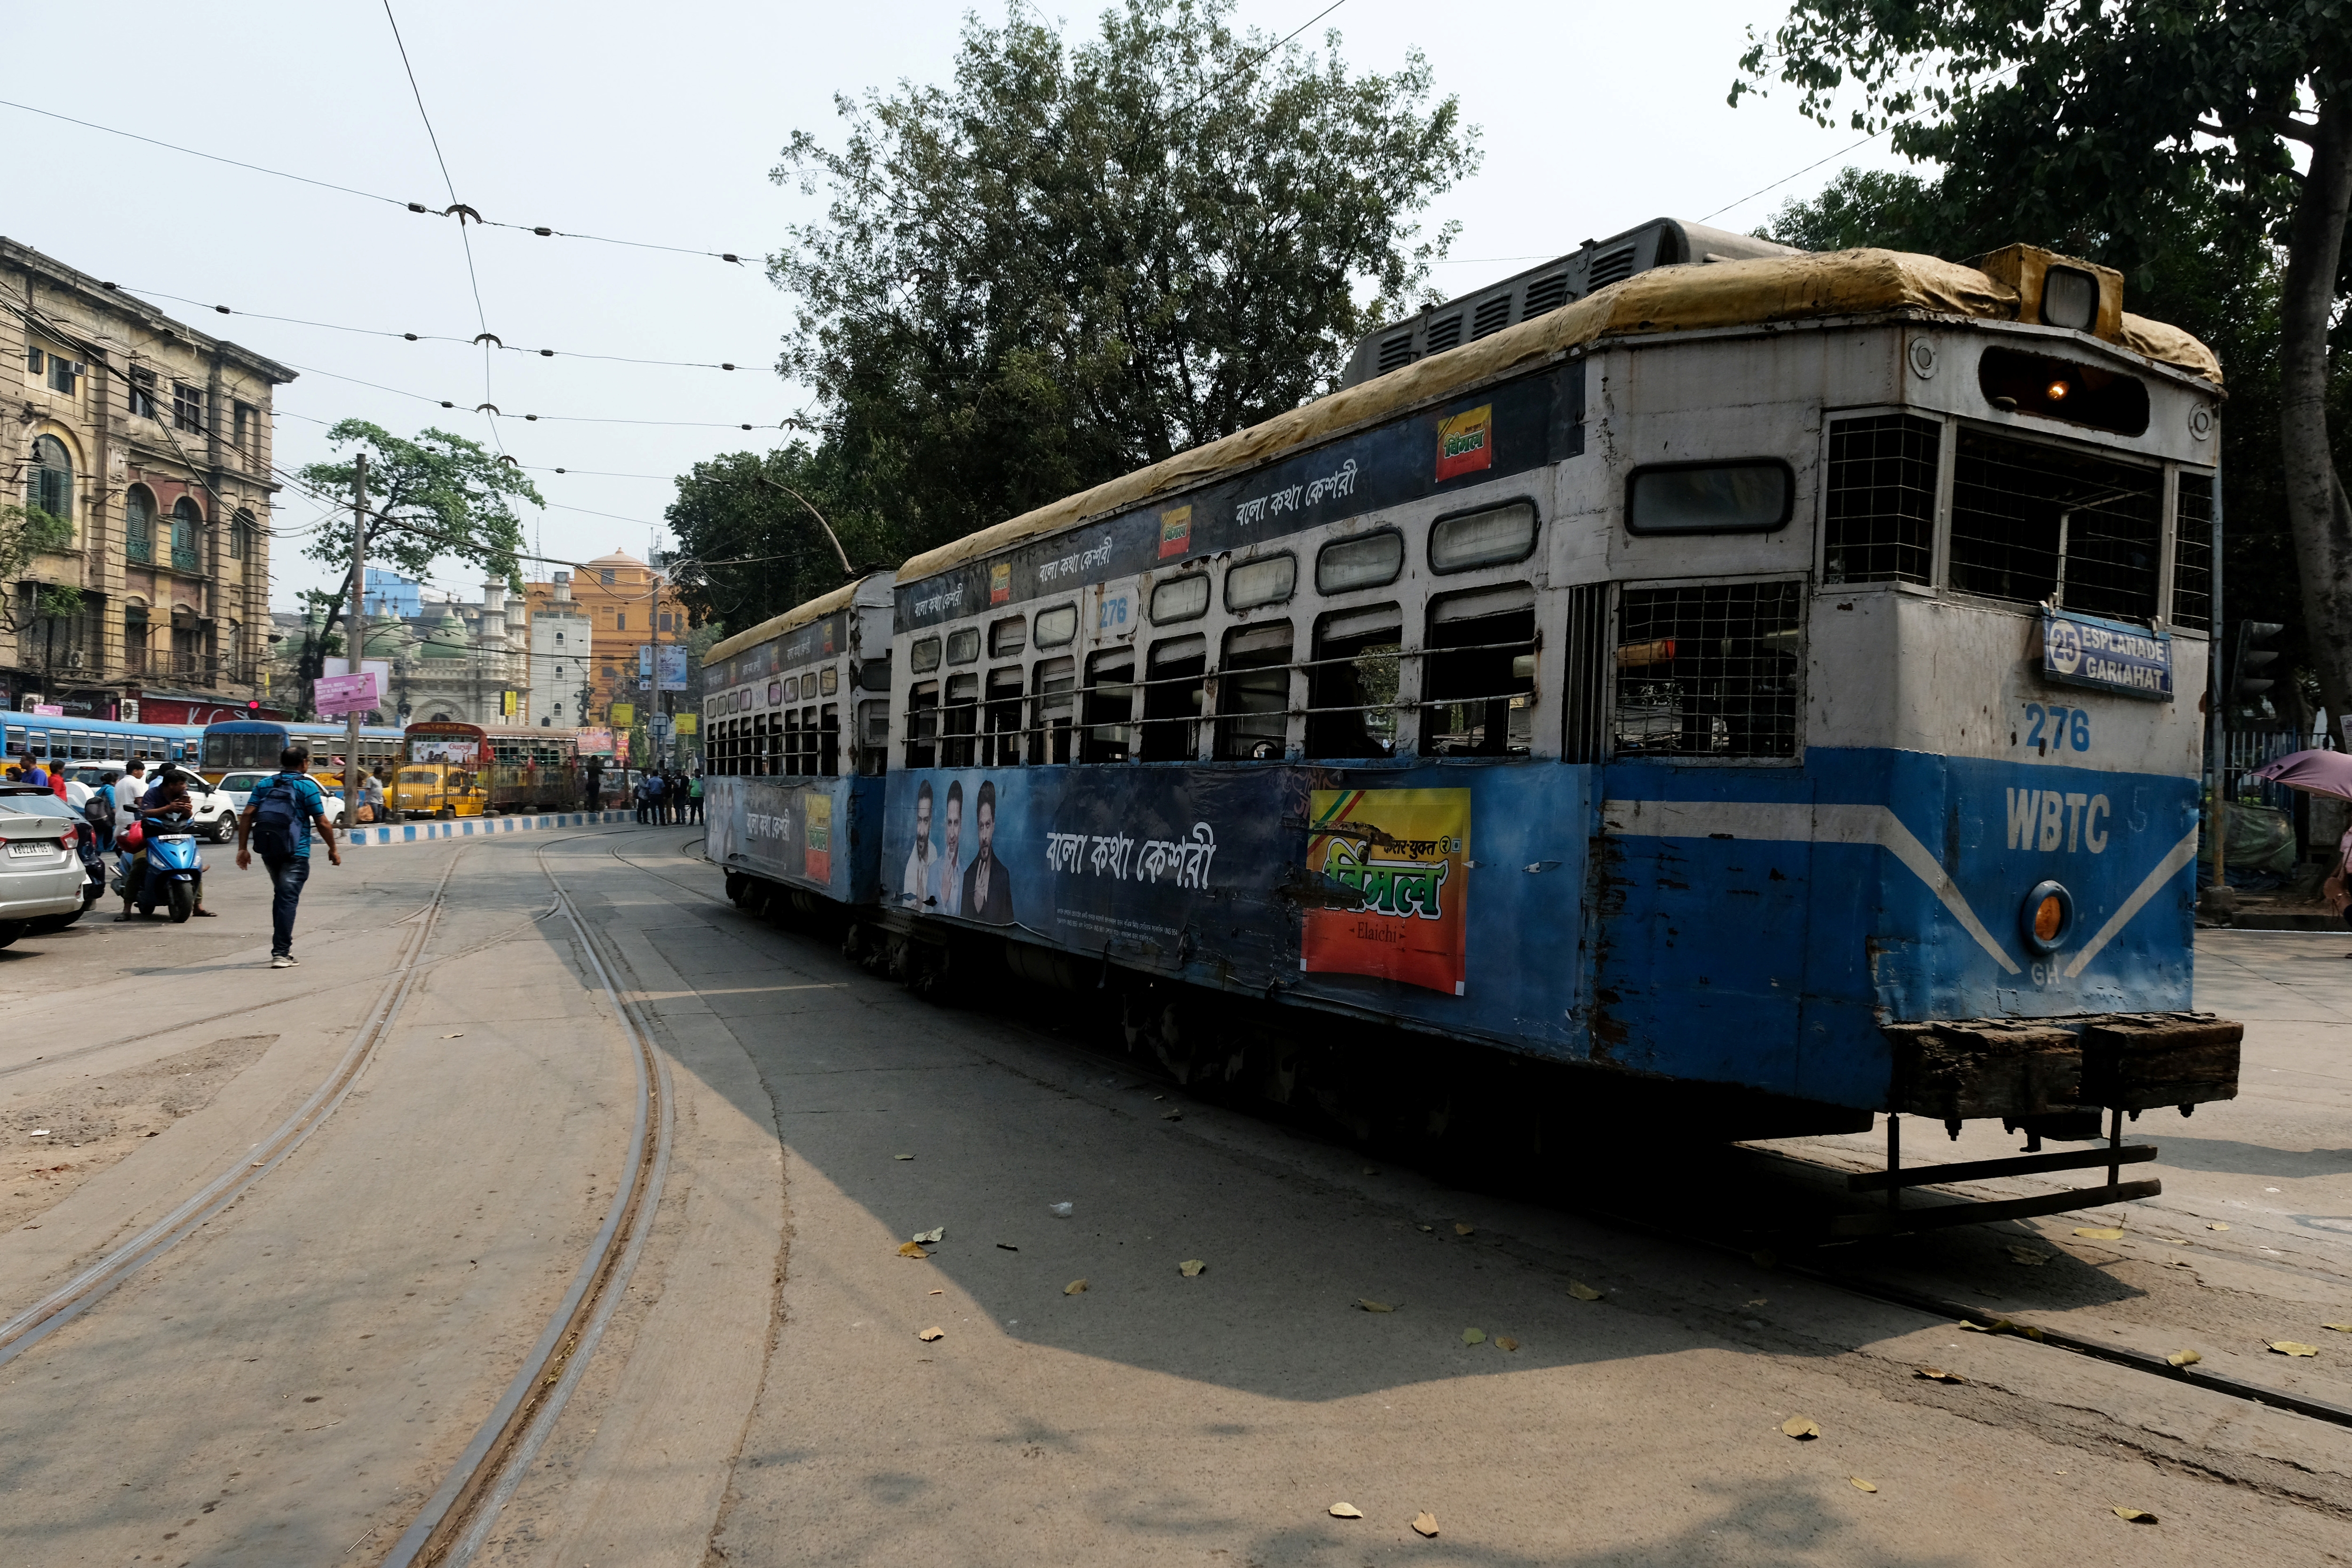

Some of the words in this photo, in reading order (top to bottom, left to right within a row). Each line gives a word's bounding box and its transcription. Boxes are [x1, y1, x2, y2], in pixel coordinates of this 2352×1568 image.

[1236, 496, 1268, 526] বলো
[1270, 484, 1303, 516] কথা
[1305, 459, 1358, 506] কেশরী
[1039, 560, 1058, 582] বলো
[1060, 552, 1080, 576] কথা
[1081, 536, 1112, 571] কেশরী
[915, 600, 928, 617] বলো
[929, 594, 942, 613] কথা
[943, 583, 963, 610] কেশরী
[1100, 597, 1127, 629] 276
[2053, 629, 2077, 662] 25
[2081, 626, 2165, 661] ESPLANADE
[2086, 657, 2164, 690] GARIAHAT
[2026, 703, 2090, 752] 276
[2006, 788, 2110, 854] WBTC
[1046, 832, 1087, 875] বলো
[1091, 831, 1134, 880] কথা
[1136, 822, 1217, 890] কেশরী
[1357, 922, 1397, 942] Elaichi
[2031, 963, 2060, 986] GH
